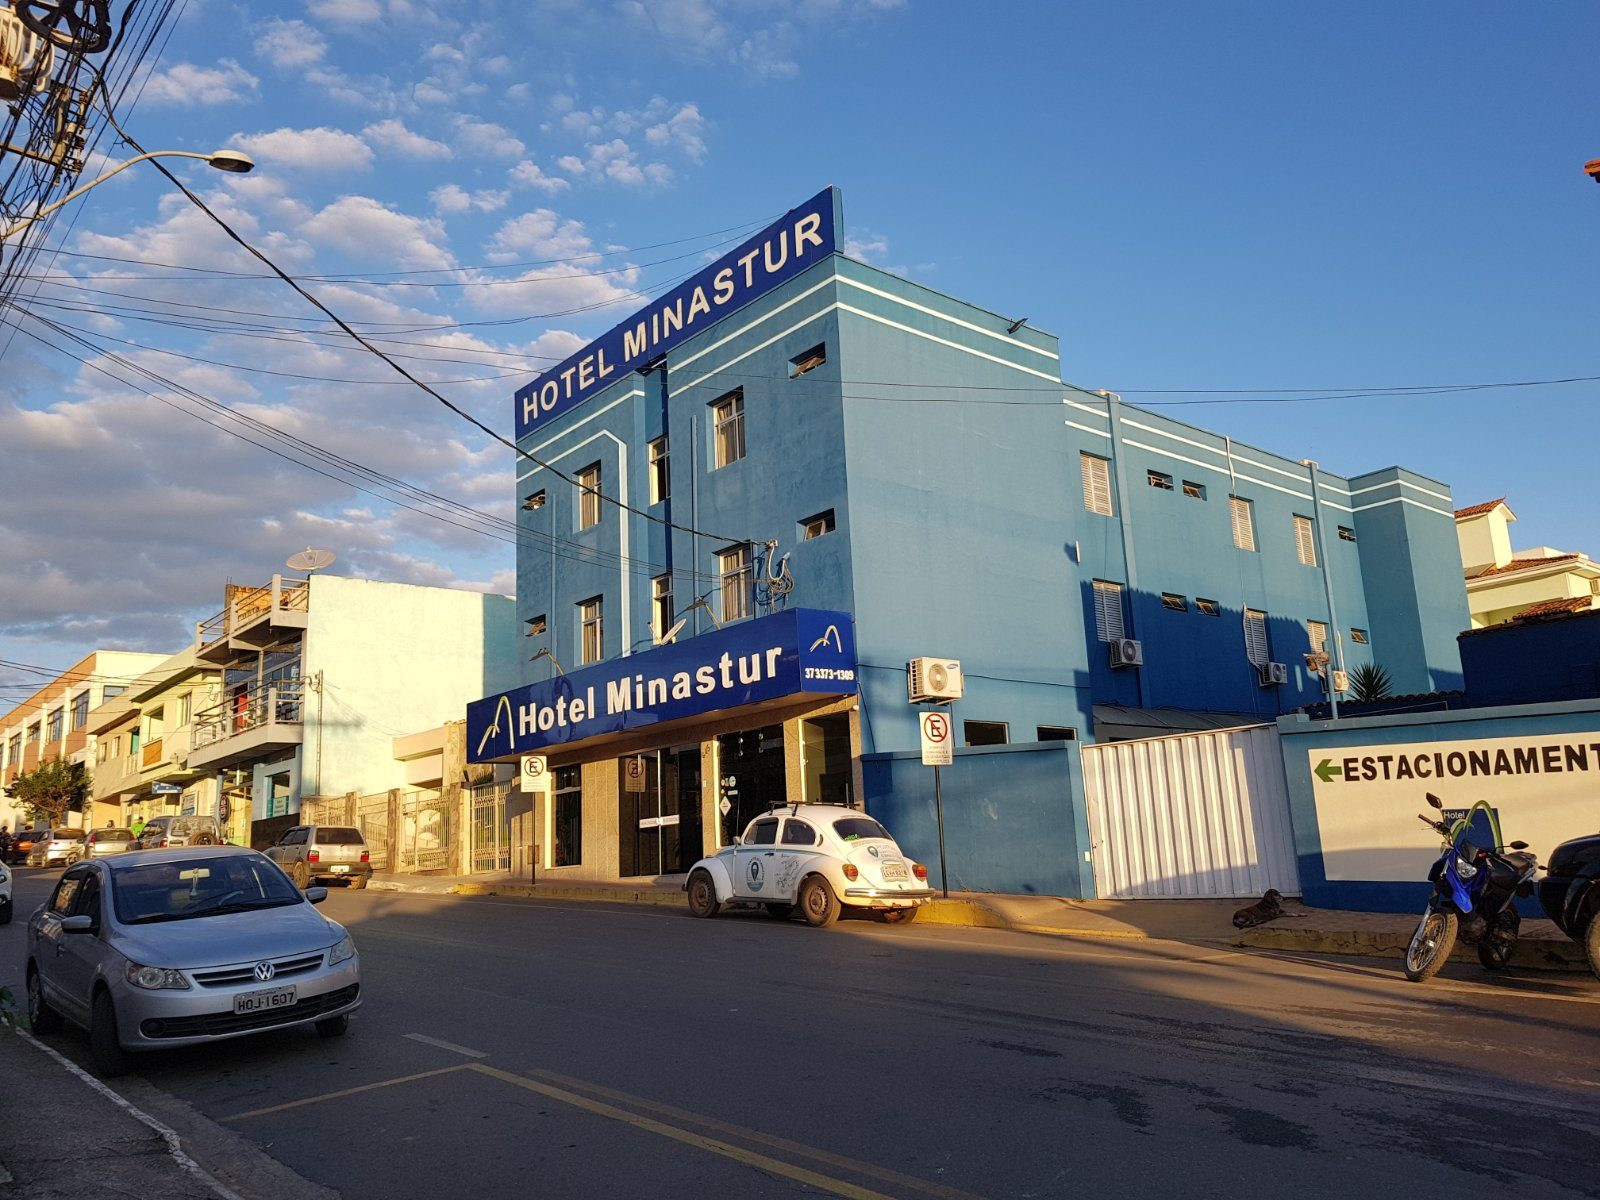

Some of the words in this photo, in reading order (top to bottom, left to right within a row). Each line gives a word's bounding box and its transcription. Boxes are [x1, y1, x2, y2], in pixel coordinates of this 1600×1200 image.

[523, 347, 615, 426] HOTEL
[623, 212, 824, 362] MINASTUR
[518, 686, 596, 737] Hotel
[606, 646, 782, 716] Minastur
[1443, 810, 1467, 820] Hotel
